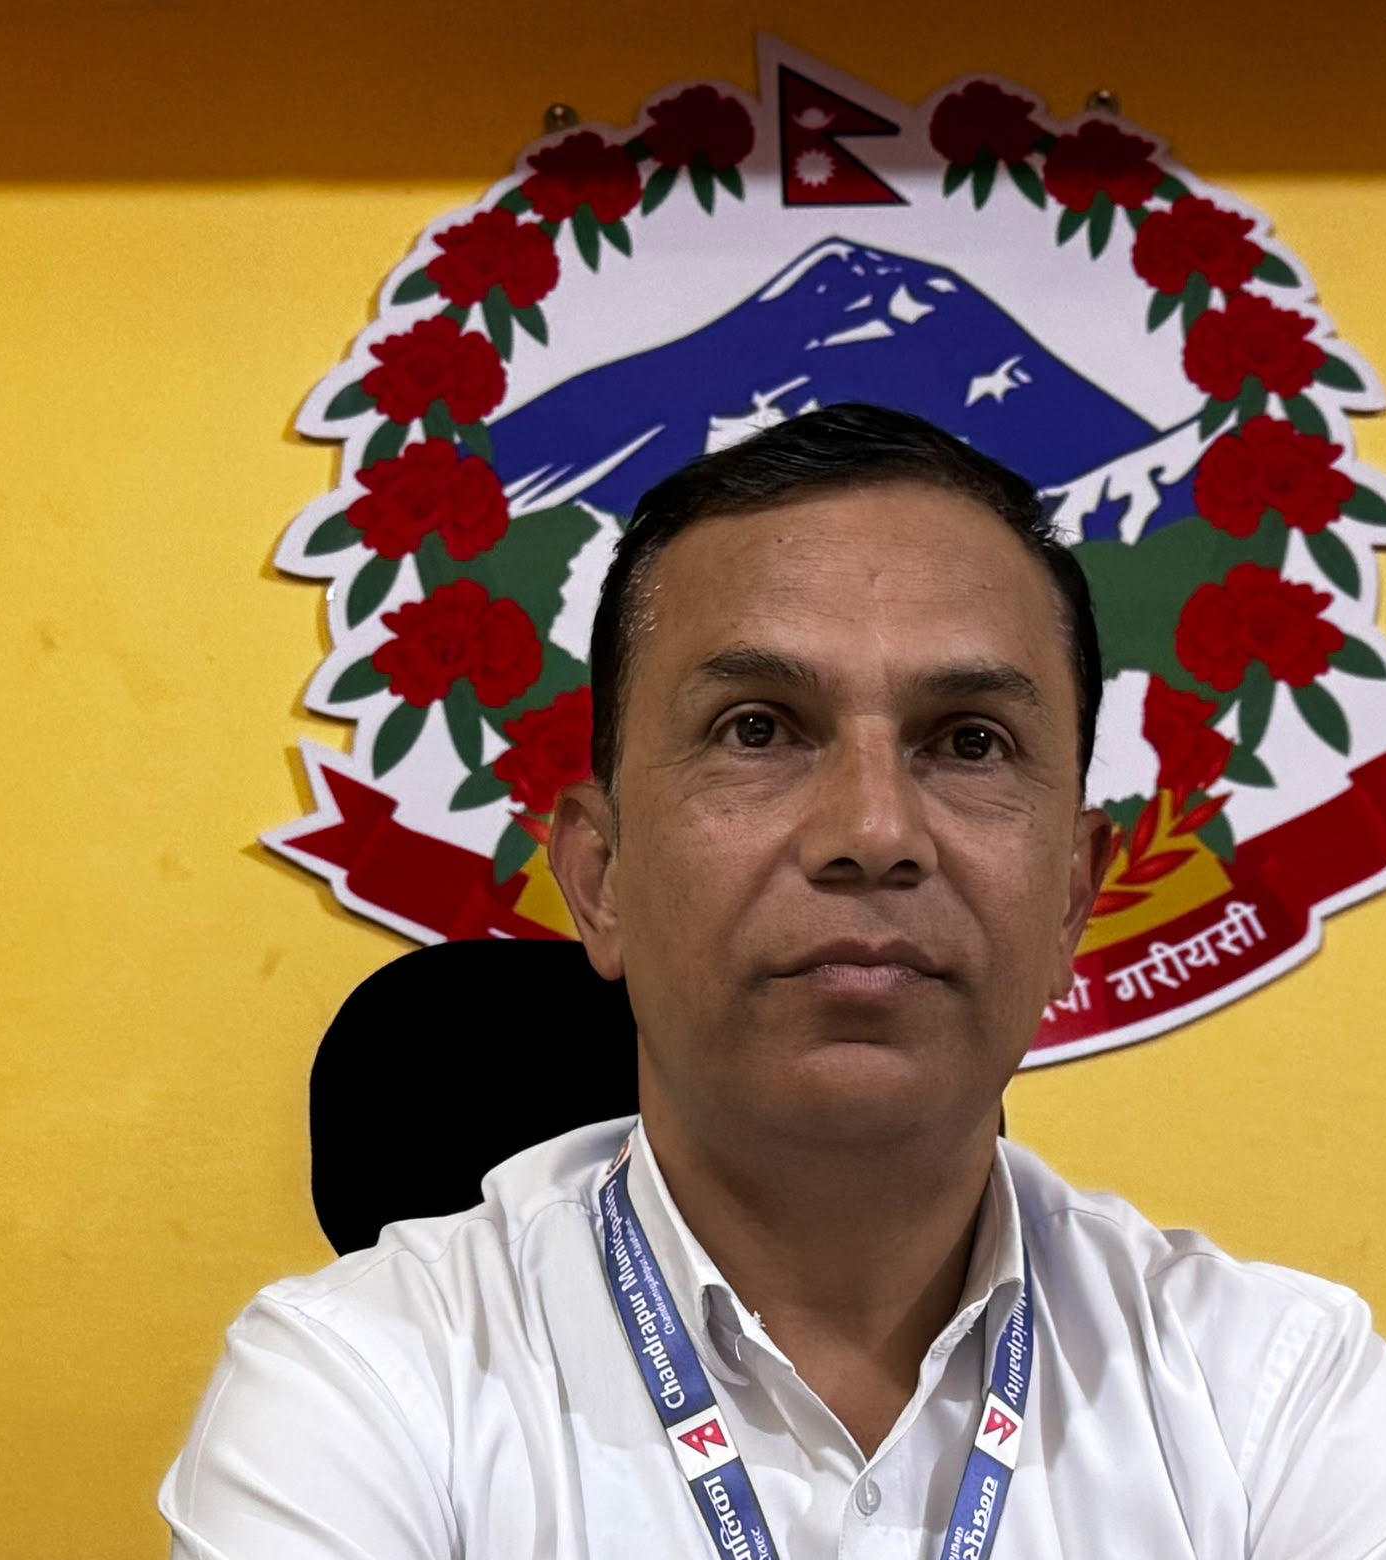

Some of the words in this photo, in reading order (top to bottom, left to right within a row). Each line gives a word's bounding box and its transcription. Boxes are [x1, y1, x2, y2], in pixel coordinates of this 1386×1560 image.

[1106, 901, 1267, 1001] गरीयसी
[605, 1179, 638, 1292] Municipality
[629, 1292, 686, 1410] Chandrapur
